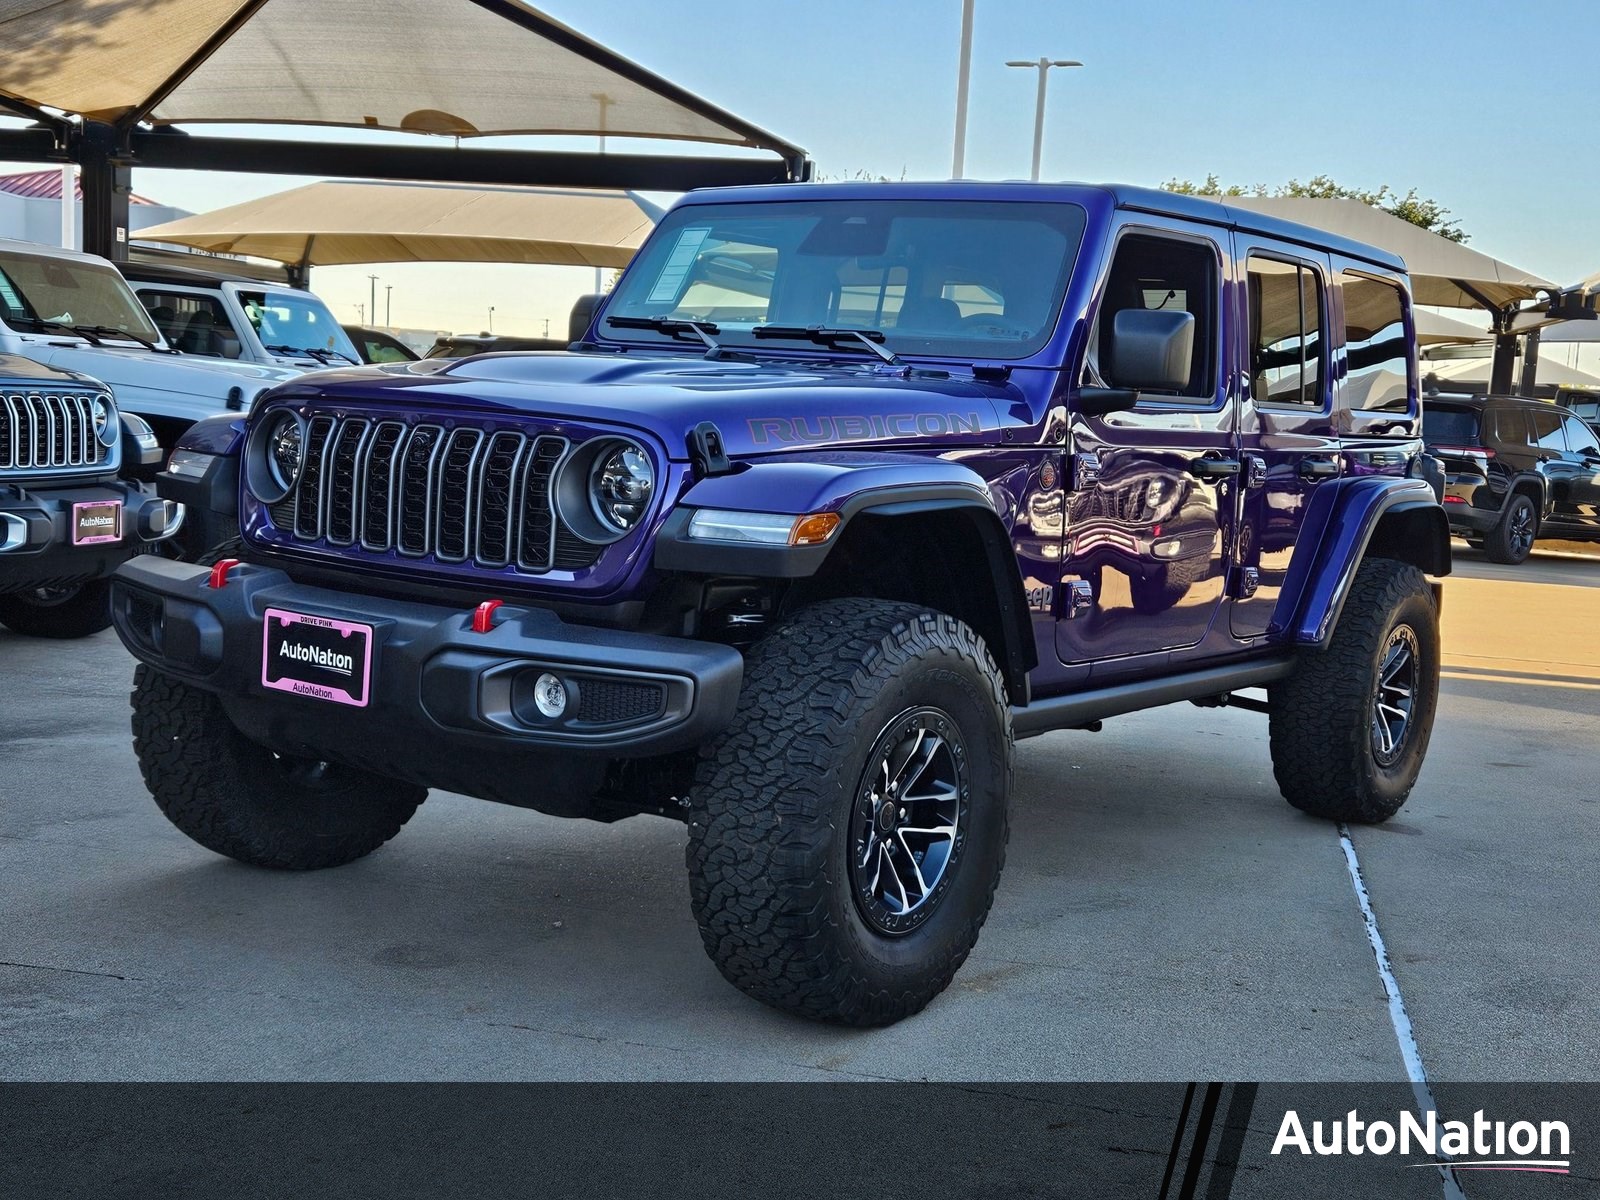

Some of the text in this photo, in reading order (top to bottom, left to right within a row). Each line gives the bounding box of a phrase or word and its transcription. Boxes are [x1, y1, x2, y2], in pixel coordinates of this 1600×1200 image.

[747, 412, 982, 444] RUBICON
[1026, 587, 1053, 611] eep
[300, 616, 317, 625] DRIVE
[280, 640, 353, 670] AutoNation
[292, 682, 333, 699] AutoNation
